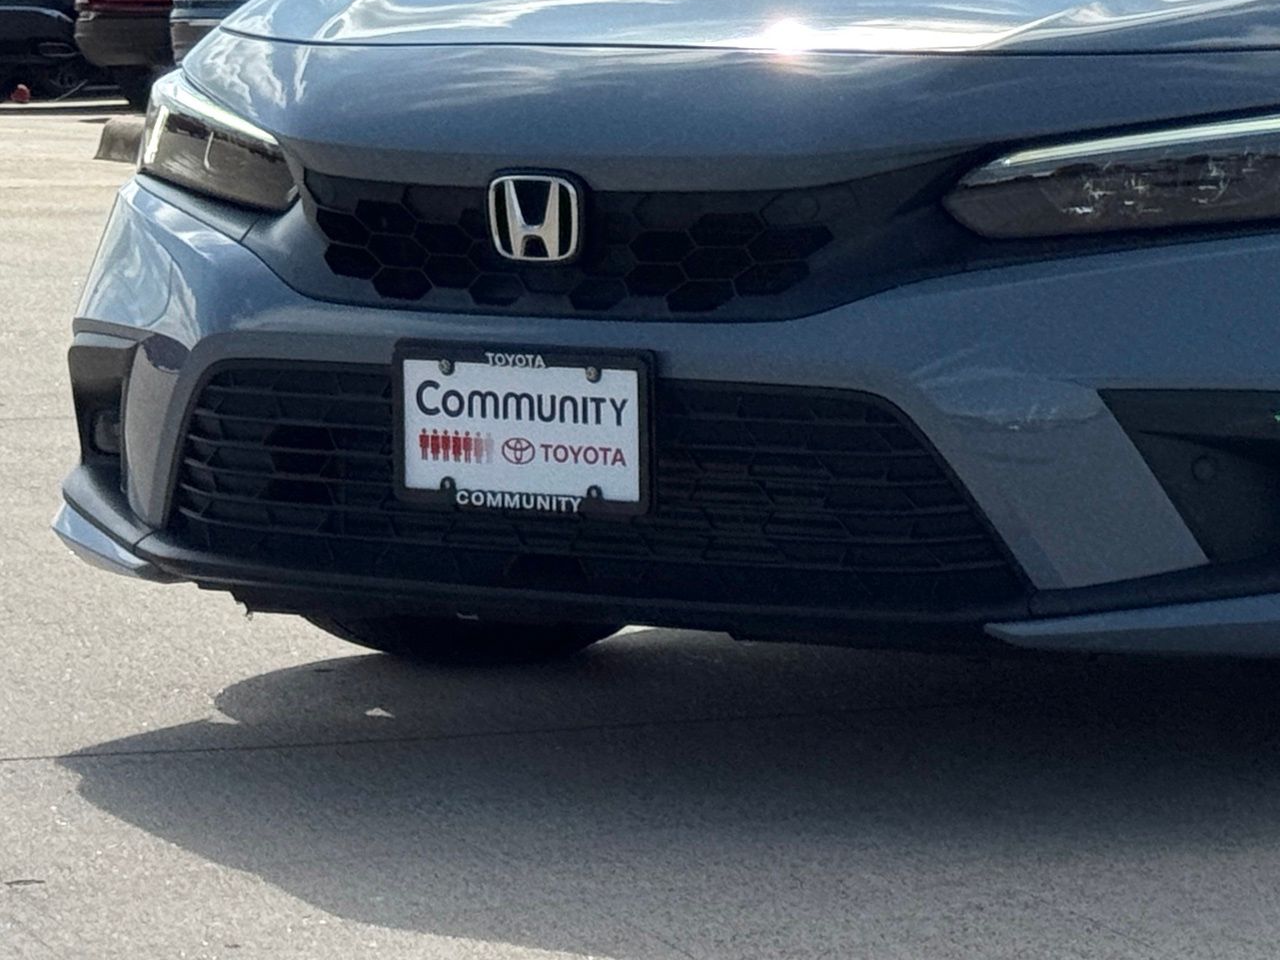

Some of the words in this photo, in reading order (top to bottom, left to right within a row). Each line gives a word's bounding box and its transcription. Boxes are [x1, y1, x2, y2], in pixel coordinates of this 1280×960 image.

[484, 351, 547, 369] TOYOTA
[540, 443, 627, 467] TOYOTA
[455, 490, 582, 513] COMMUNITY
